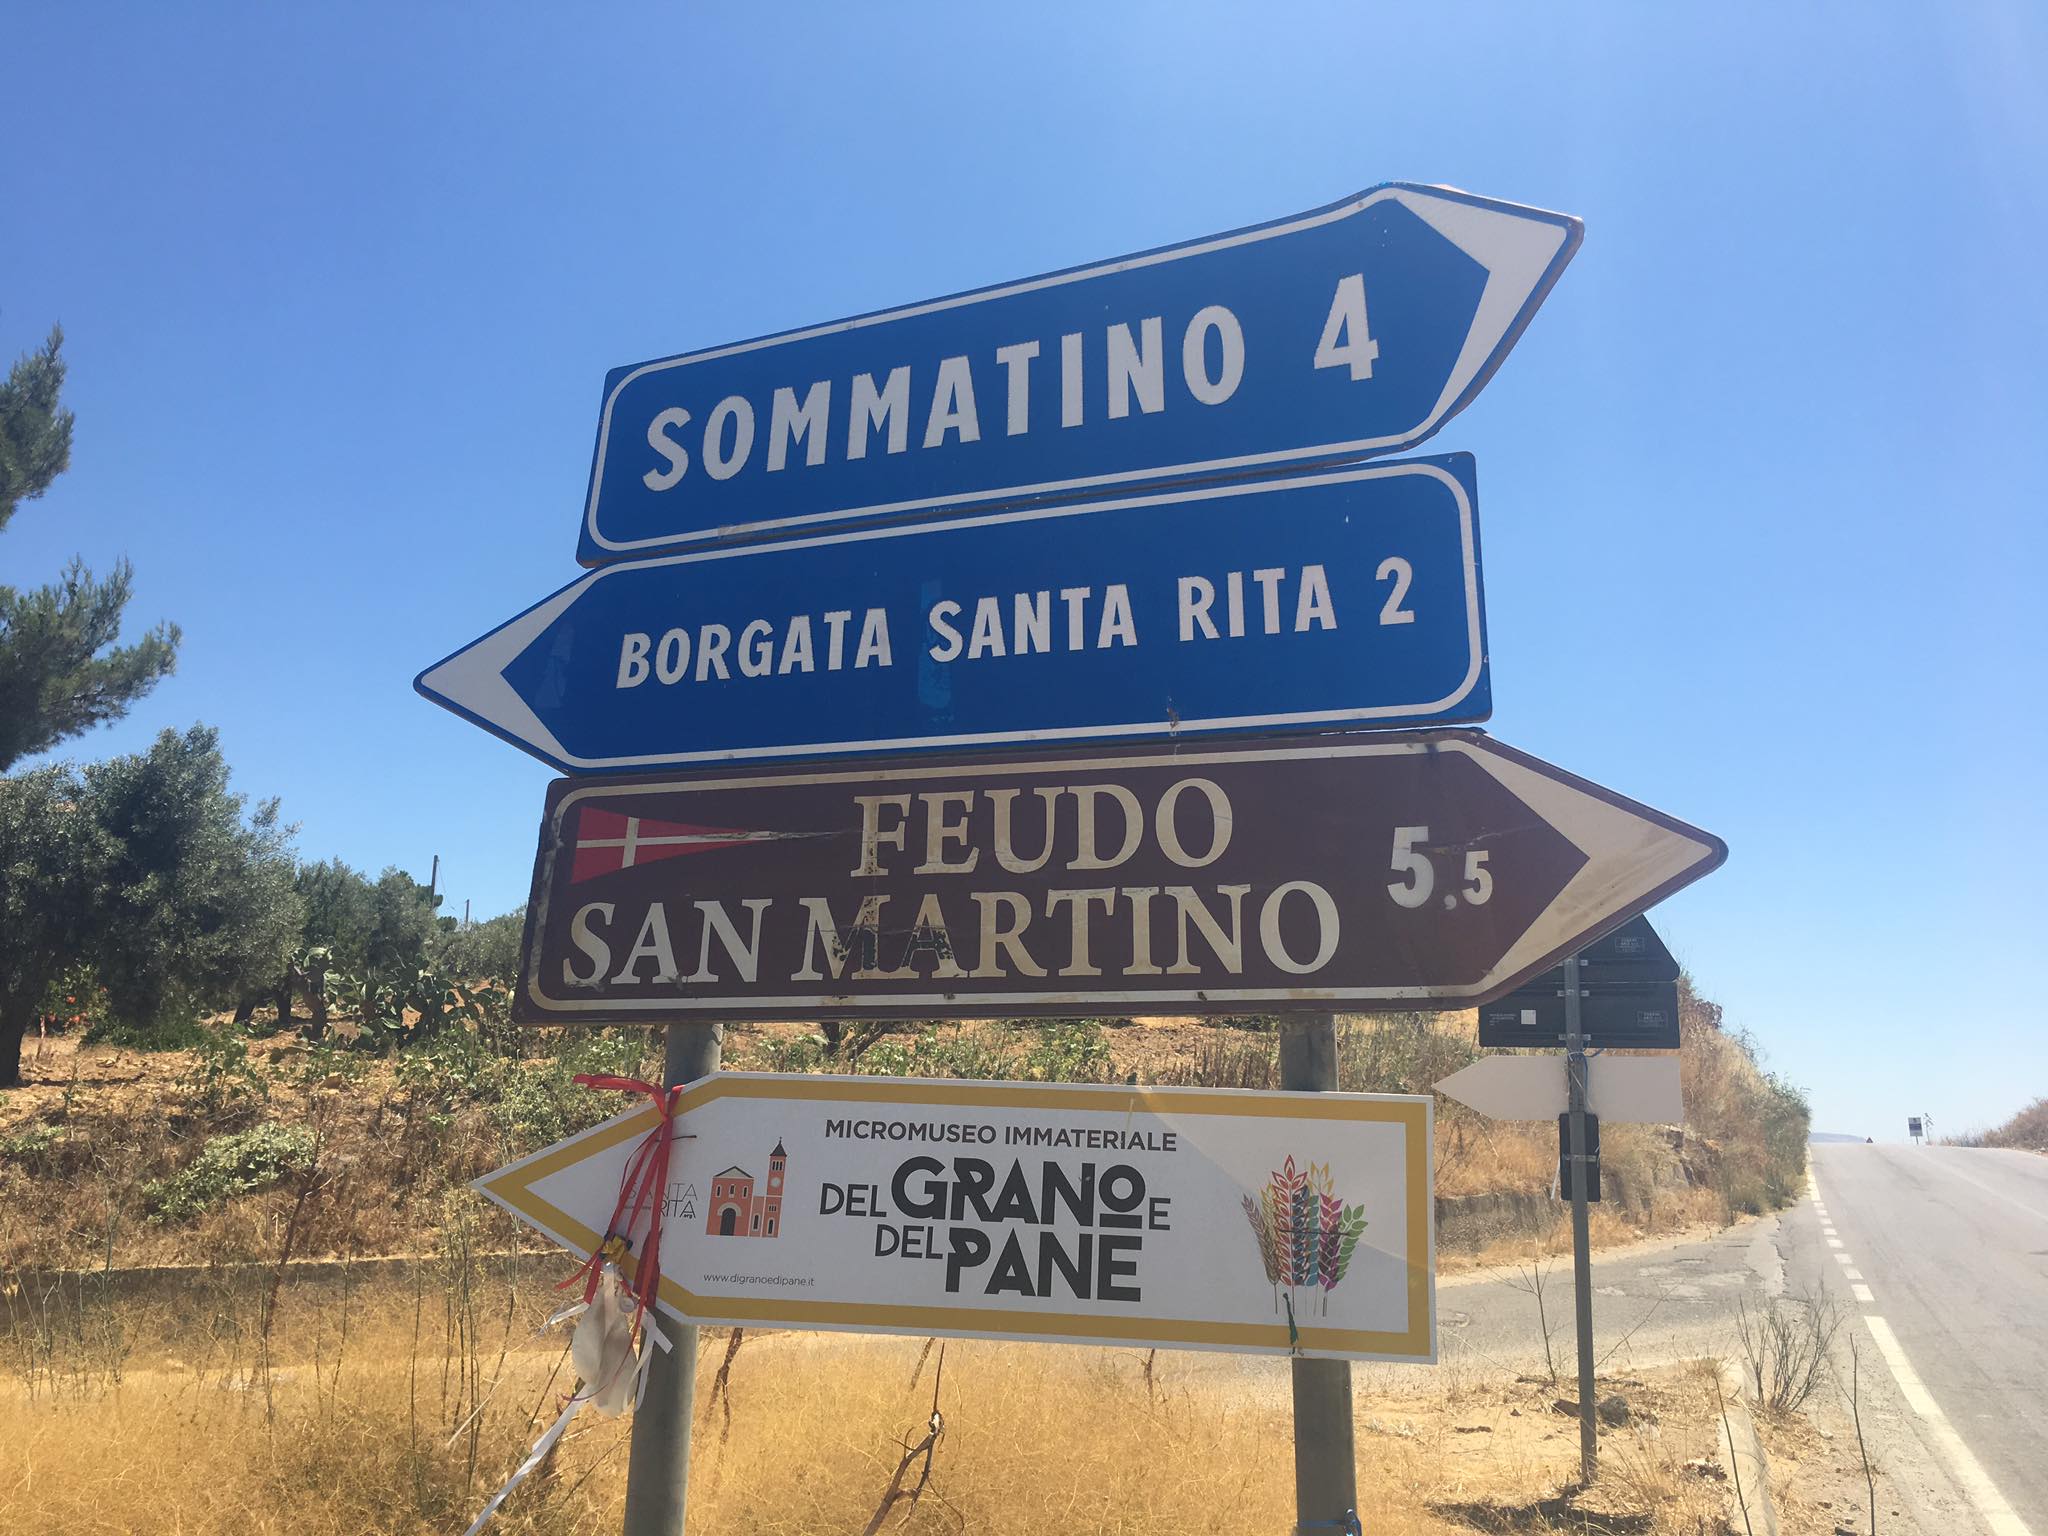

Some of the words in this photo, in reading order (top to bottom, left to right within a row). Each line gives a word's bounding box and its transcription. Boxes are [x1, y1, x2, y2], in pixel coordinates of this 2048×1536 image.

[643, 304, 1246, 492] SOMMATINO
[1313, 273, 1379, 381] 4
[616, 607, 893, 690] BORGATA
[928, 583, 1138, 663] SANTA
[1177, 564, 1338, 642] RITA
[1375, 556, 1415, 626] 2
[850, 777, 1233, 878] FEUDO
[563, 898, 773, 988] SAN
[790, 880, 1341, 981] MARTINO
[825, 1119, 997, 1145] MICROMUSEO
[1004, 1126, 1177, 1152] IMMATERIALE
[819, 1182, 887, 1218] DEL
[891, 1155, 1146, 1230] GRANO
[1148, 1196, 1172, 1231] E
[703, 1273, 815, 1287] www.digranoedipane.it
[874, 1223, 944, 1260] DEL
[945, 1227, 1143, 1302] PANE
